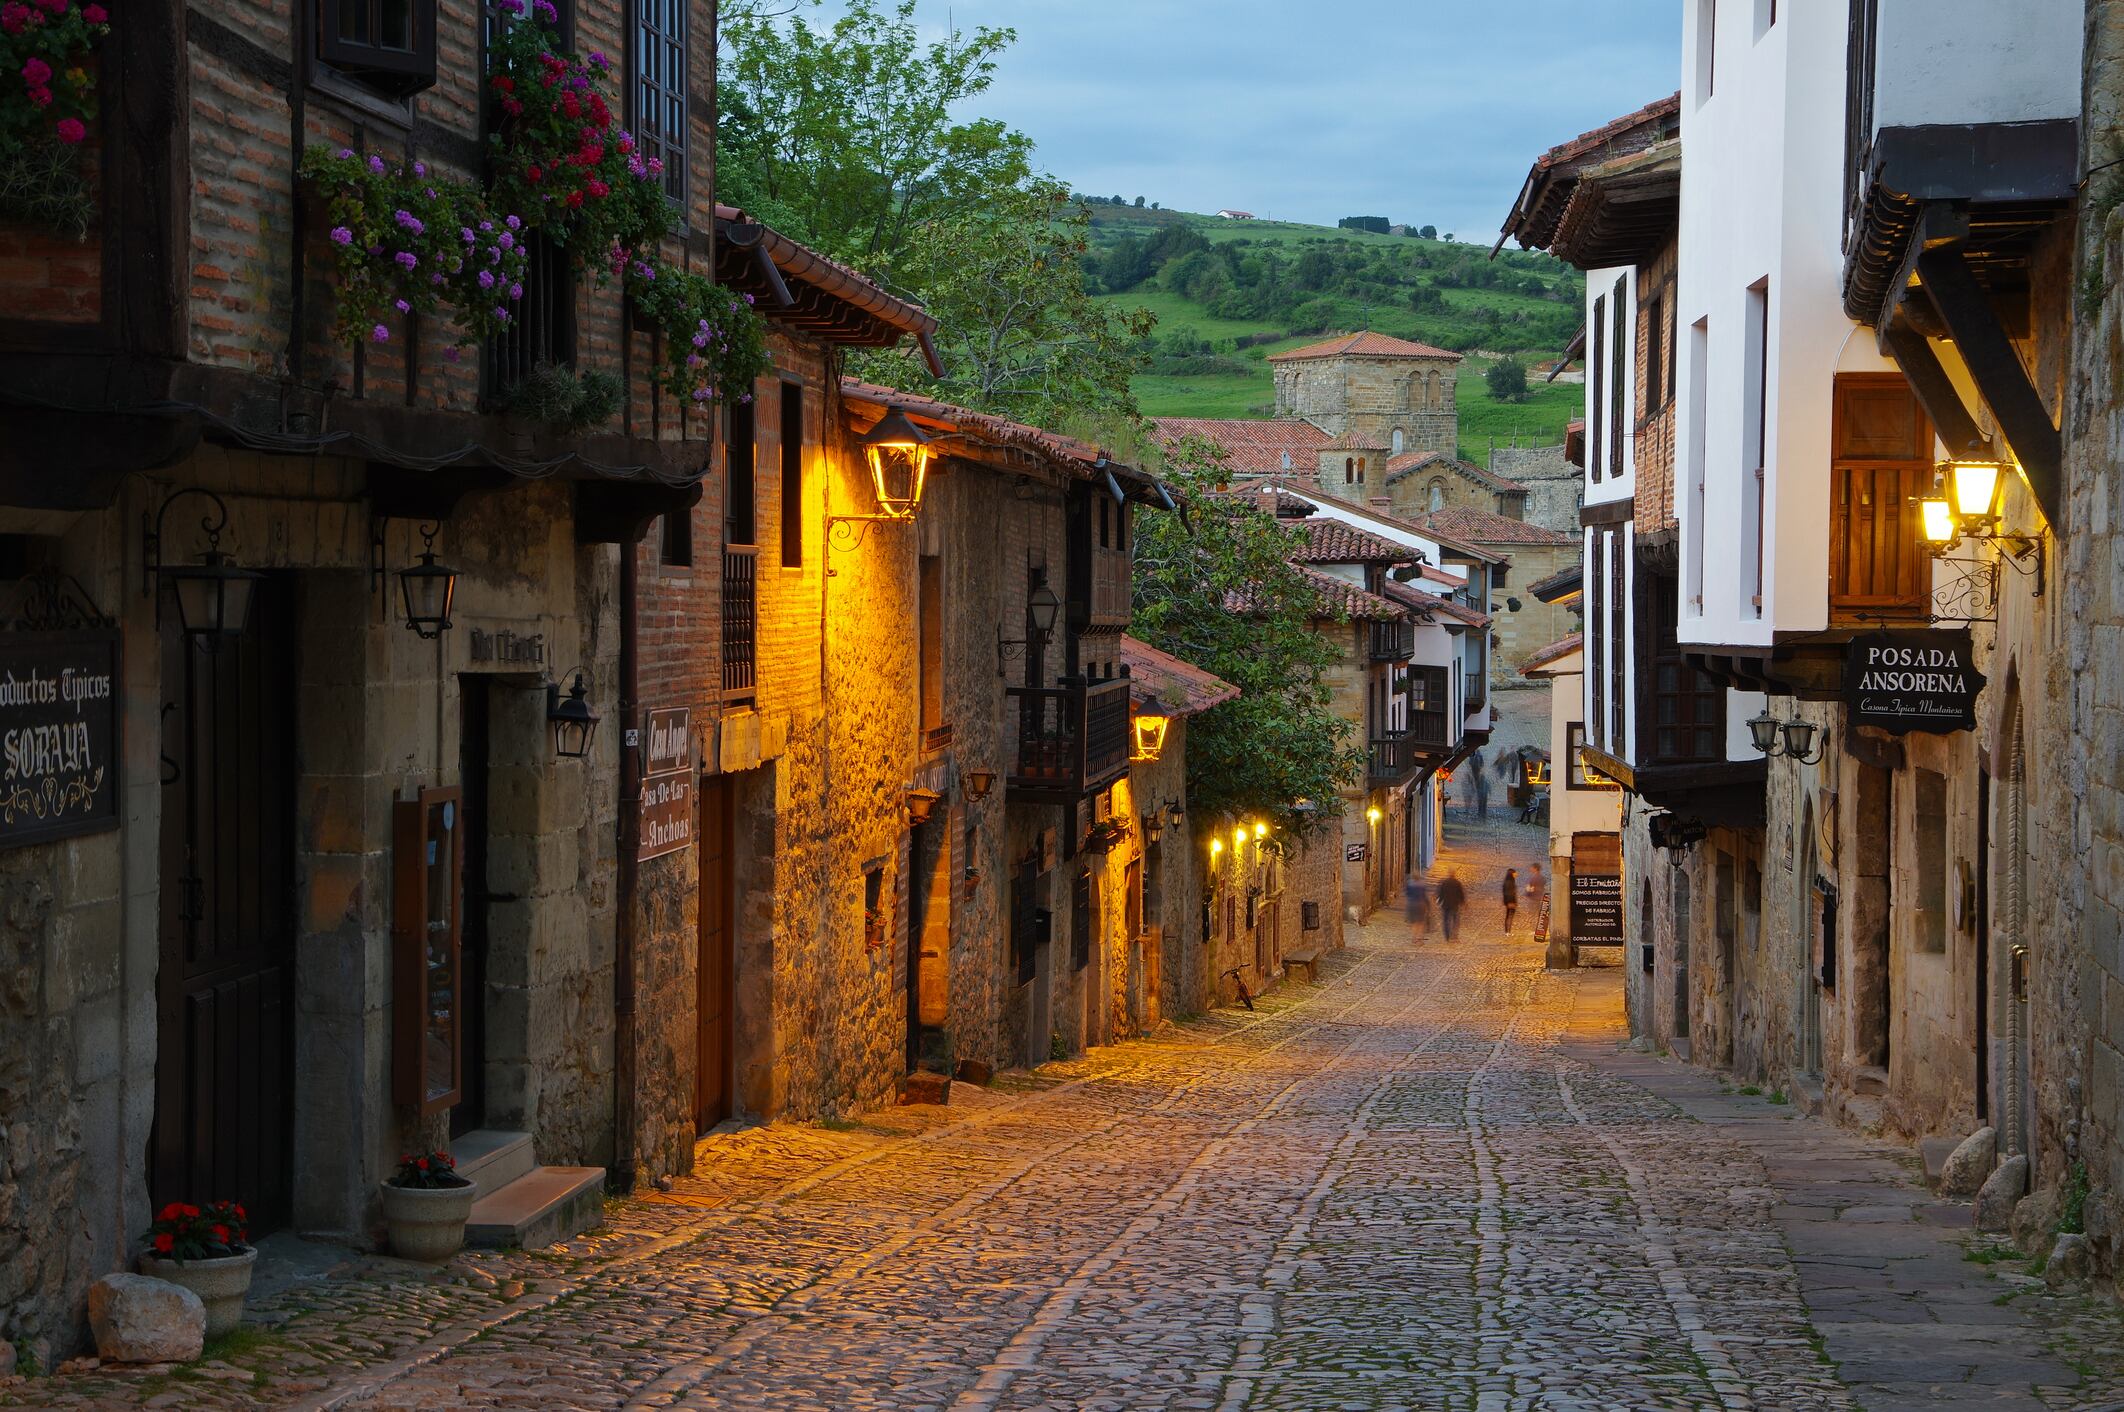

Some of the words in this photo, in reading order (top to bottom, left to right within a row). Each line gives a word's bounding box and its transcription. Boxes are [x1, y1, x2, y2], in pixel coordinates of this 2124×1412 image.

[1868, 647, 1959, 668] POSADA
[1859, 671, 1967, 694] ANSORENA
[1860, 697, 1889, 712] Casona
[1919, 699, 1963, 714] Montañesa
[4, 721, 92, 782] SORAYA
[650, 719, 667, 762] Casa
[667, 712, 688, 769] Angel
[640, 786, 656, 815] Casa
[657, 782, 669, 804] De
[670, 779, 684, 801] Las
[649, 813, 689, 848] Anchoas
[1576, 878, 1588, 887] El
